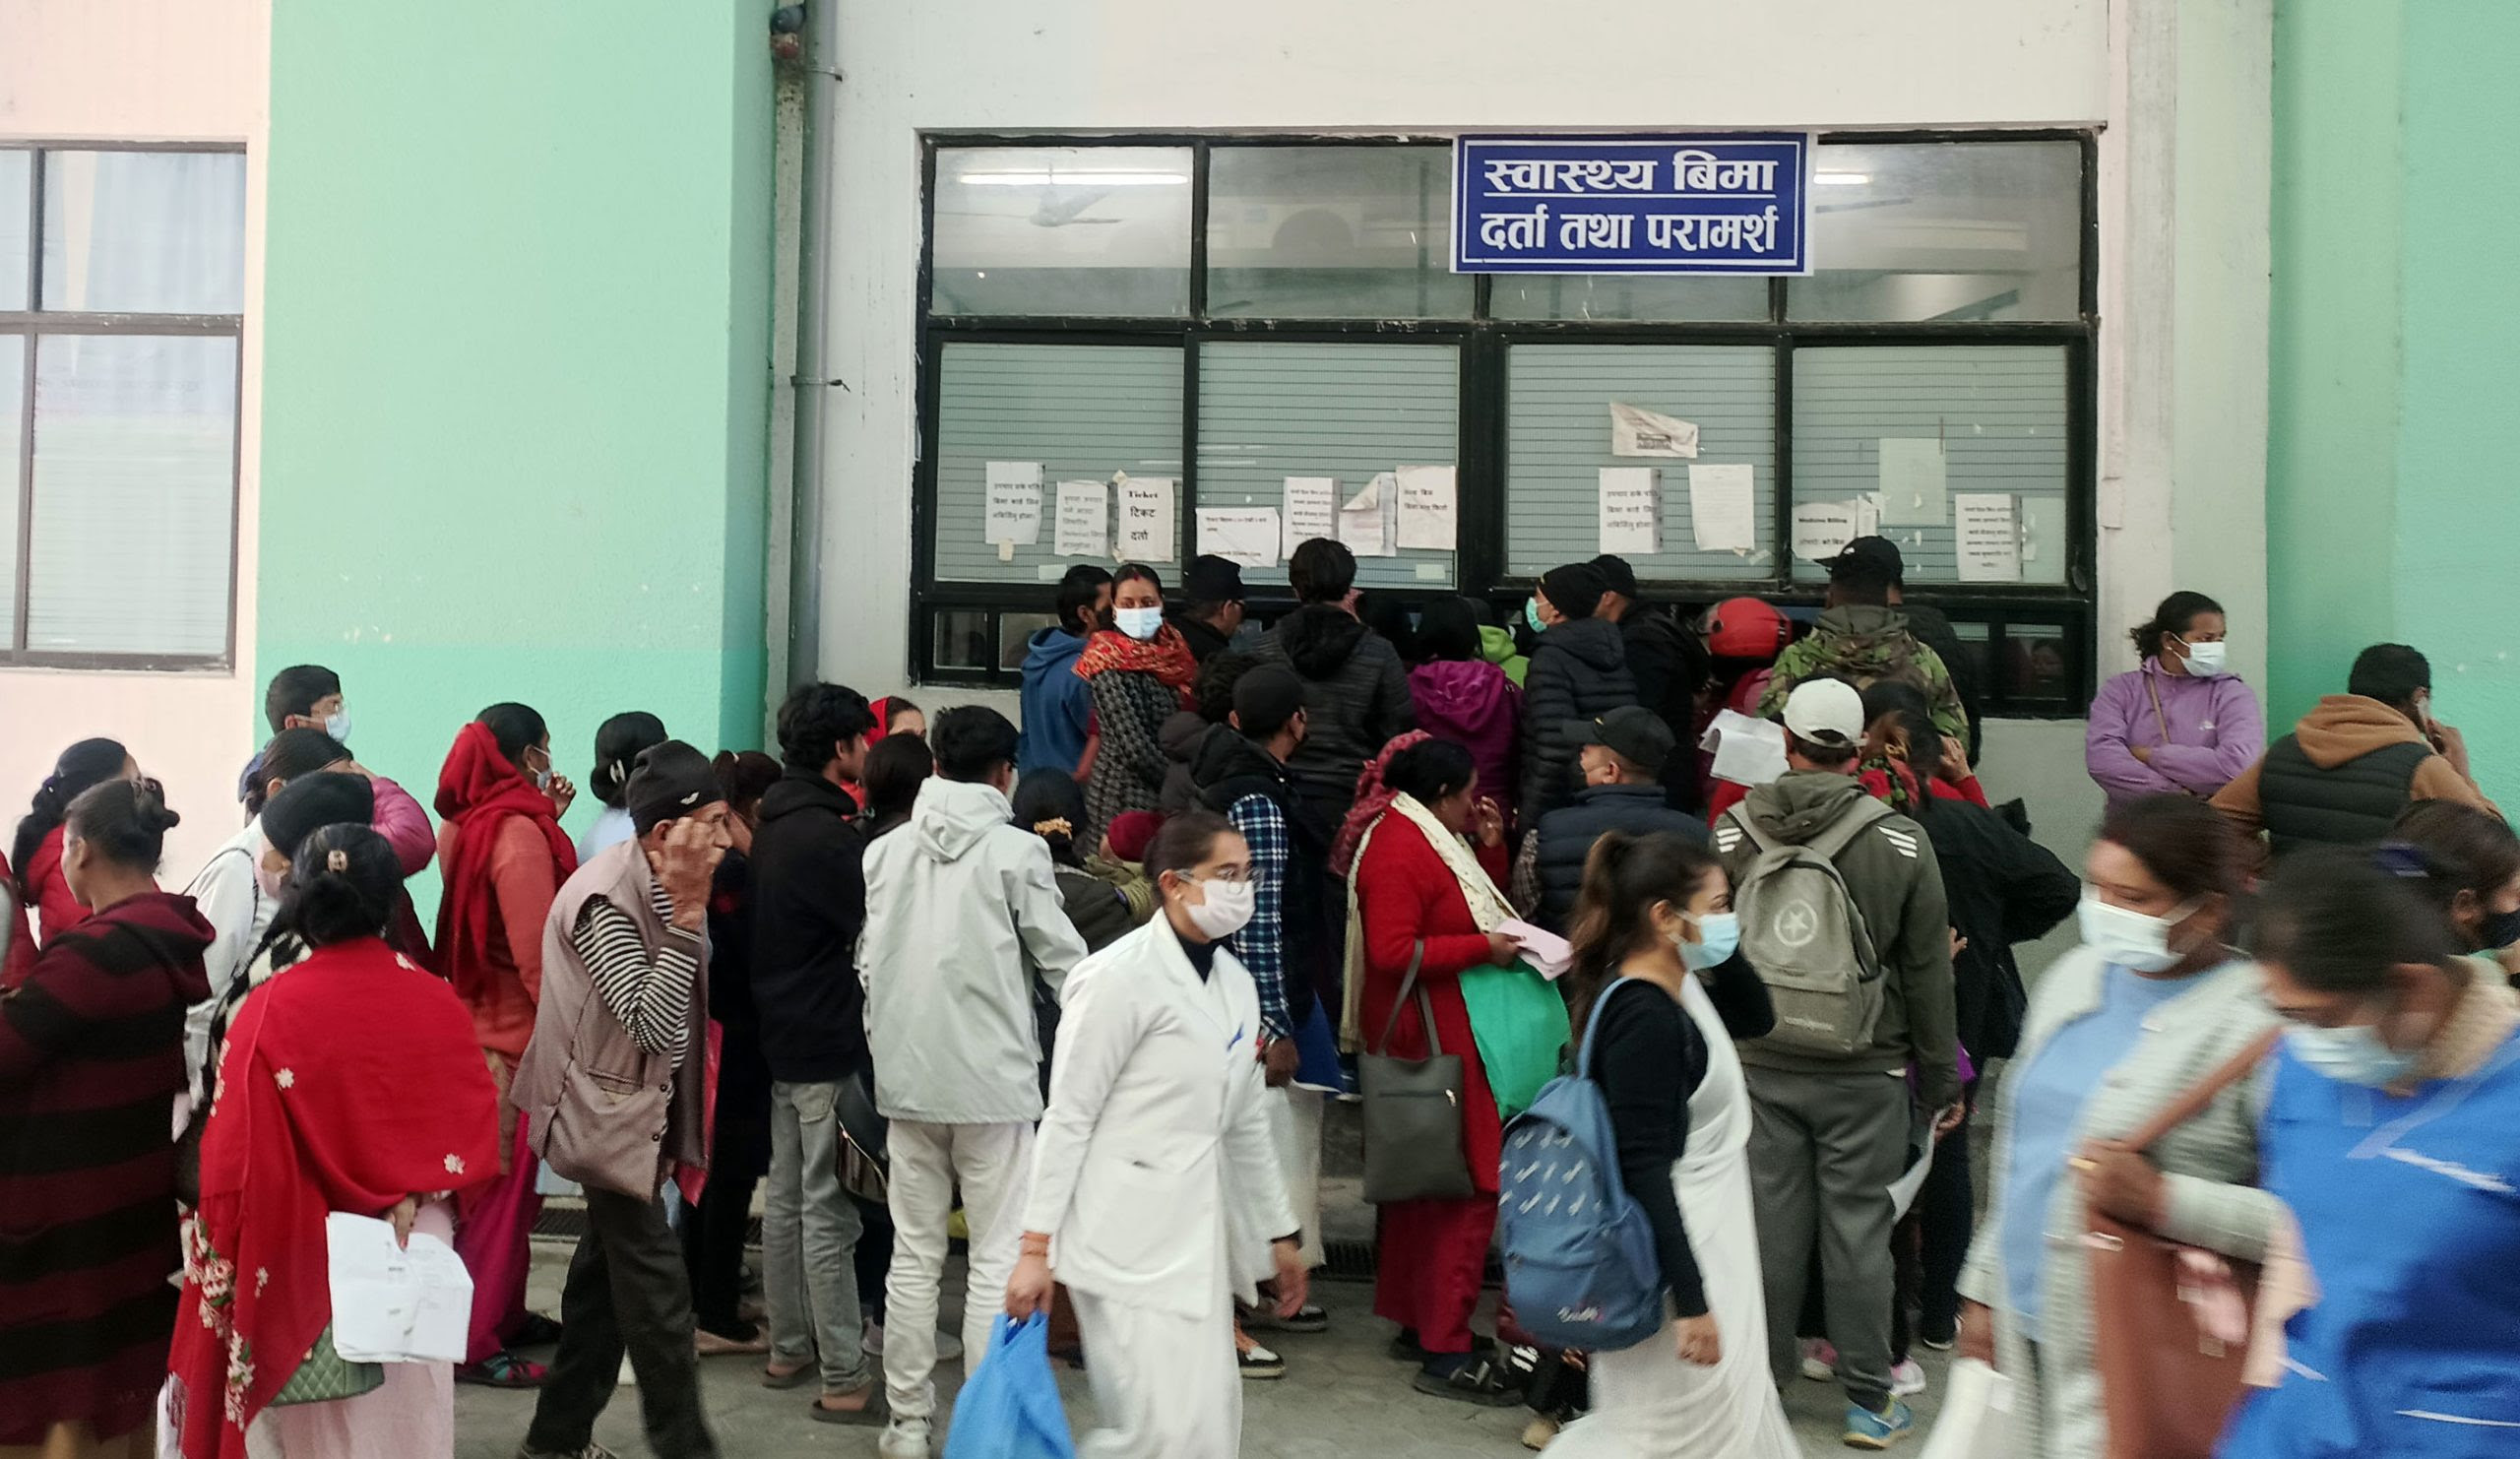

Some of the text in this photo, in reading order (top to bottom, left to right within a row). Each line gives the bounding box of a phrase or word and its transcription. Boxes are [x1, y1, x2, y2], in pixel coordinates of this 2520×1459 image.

[1483, 150, 1779, 192] स्वास्थ्य बिमा
[1480, 203, 1779, 253] दर्ता तथा परामर्श
[1129, 505, 1157, 518] टिकट
[1130, 529, 1149, 540] दर्ता
